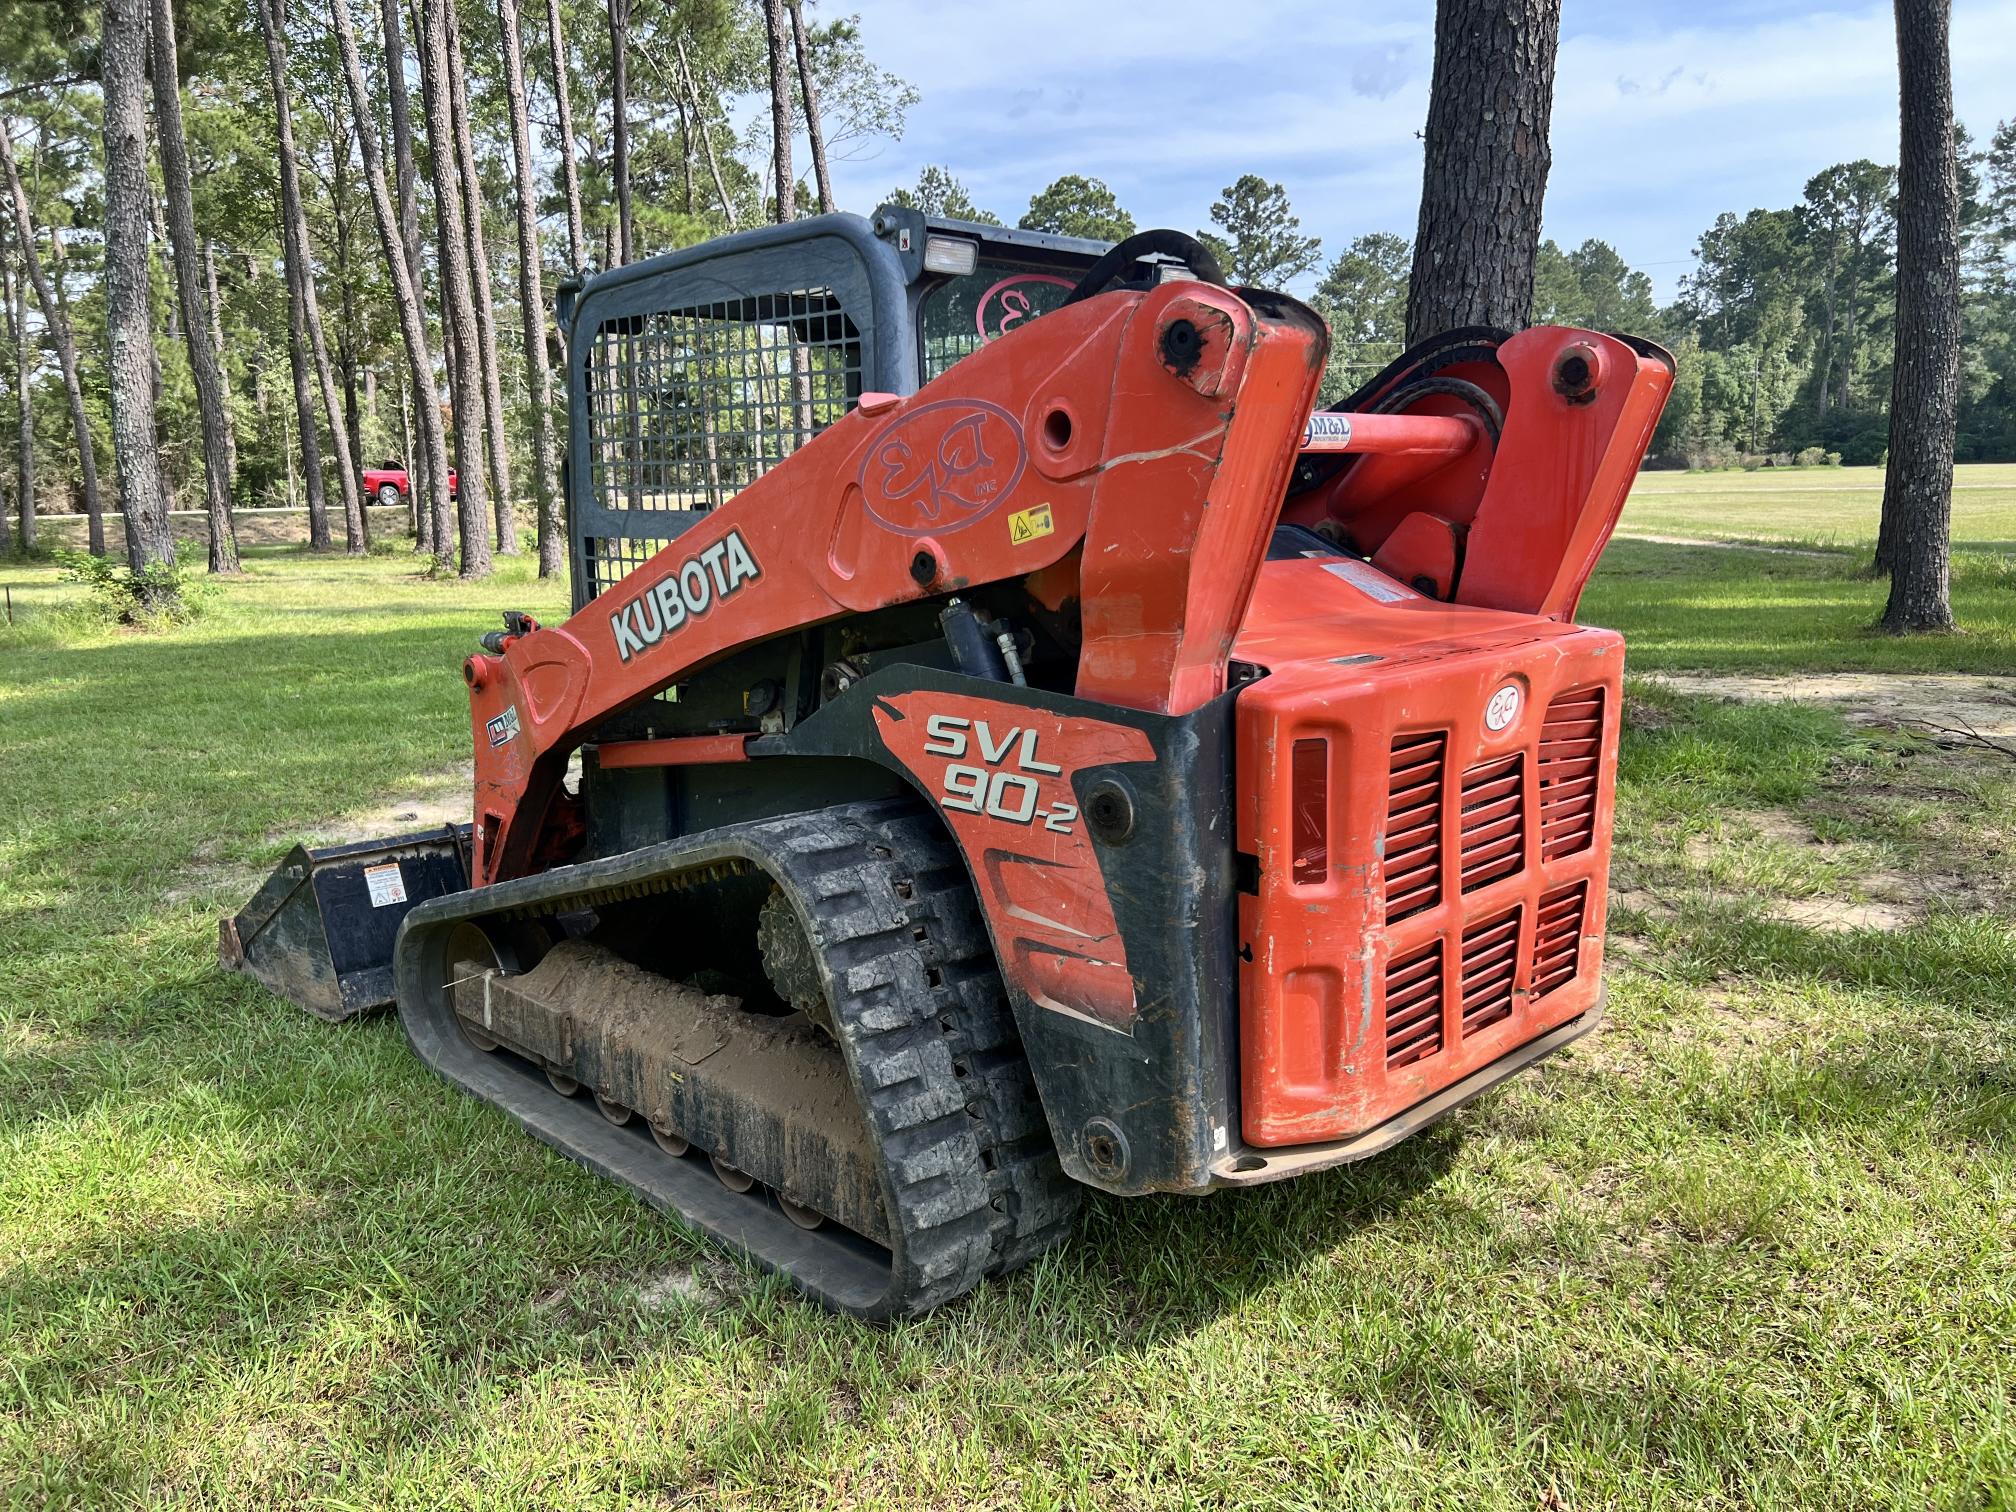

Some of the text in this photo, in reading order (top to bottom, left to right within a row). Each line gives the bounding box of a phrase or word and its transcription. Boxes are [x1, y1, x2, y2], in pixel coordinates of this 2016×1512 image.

[1311, 417, 1349, 435] M&L
[610, 531, 760, 662] KUBOTA
[923, 714, 1063, 777] SVL
[940, 763, 1079, 833] 90-2
